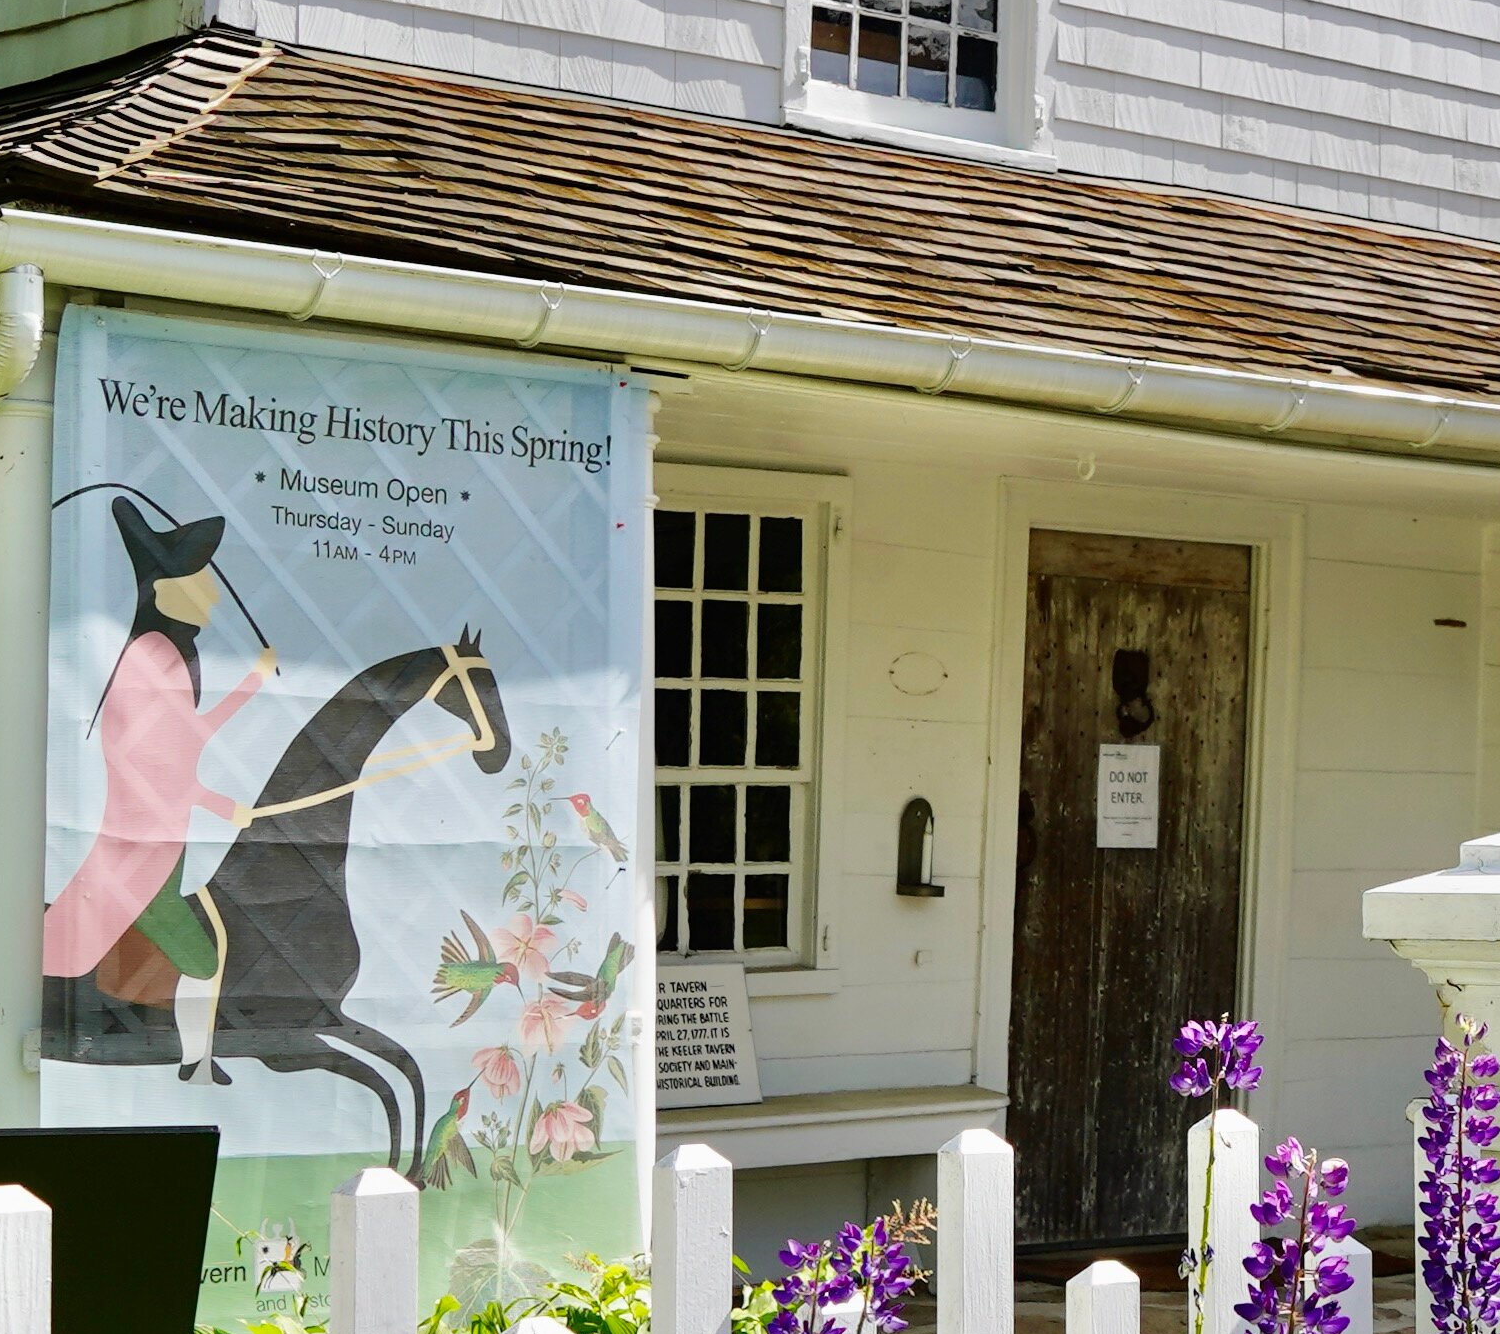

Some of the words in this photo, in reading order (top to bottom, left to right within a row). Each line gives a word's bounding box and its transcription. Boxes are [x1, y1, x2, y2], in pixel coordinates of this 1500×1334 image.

[100, 378, 186, 422] We're
[194, 390, 318, 445] Making
[325, 404, 437, 456] History
[443, 417, 505, 456] This
[511, 426, 613, 474] Spring!
[281, 468, 379, 500] Museum
[387, 477, 448, 506] Open
[271, 505, 363, 535] Thursday
[382, 517, 455, 544] Sunday
[312, 540, 360, 561] 11AM
[380, 548, 417, 566] 4PM
[1109, 770, 1125, 784] DO
[1127, 770, 1149, 784] NOT
[670, 981, 707, 993] TAVERN
[709, 995, 728, 1007] FOR
[681, 1012, 697, 1024] THE
[699, 1011, 729, 1023] BATTLE
[721, 1026, 730, 1038] IS
[671, 1044, 703, 1056] KEELER
[704, 1042, 736, 1055] TAVERN
[658, 1060, 693, 1074] SOCIETY
[694, 1059, 711, 1072] AND
[256, 1295, 287, 1313] and
